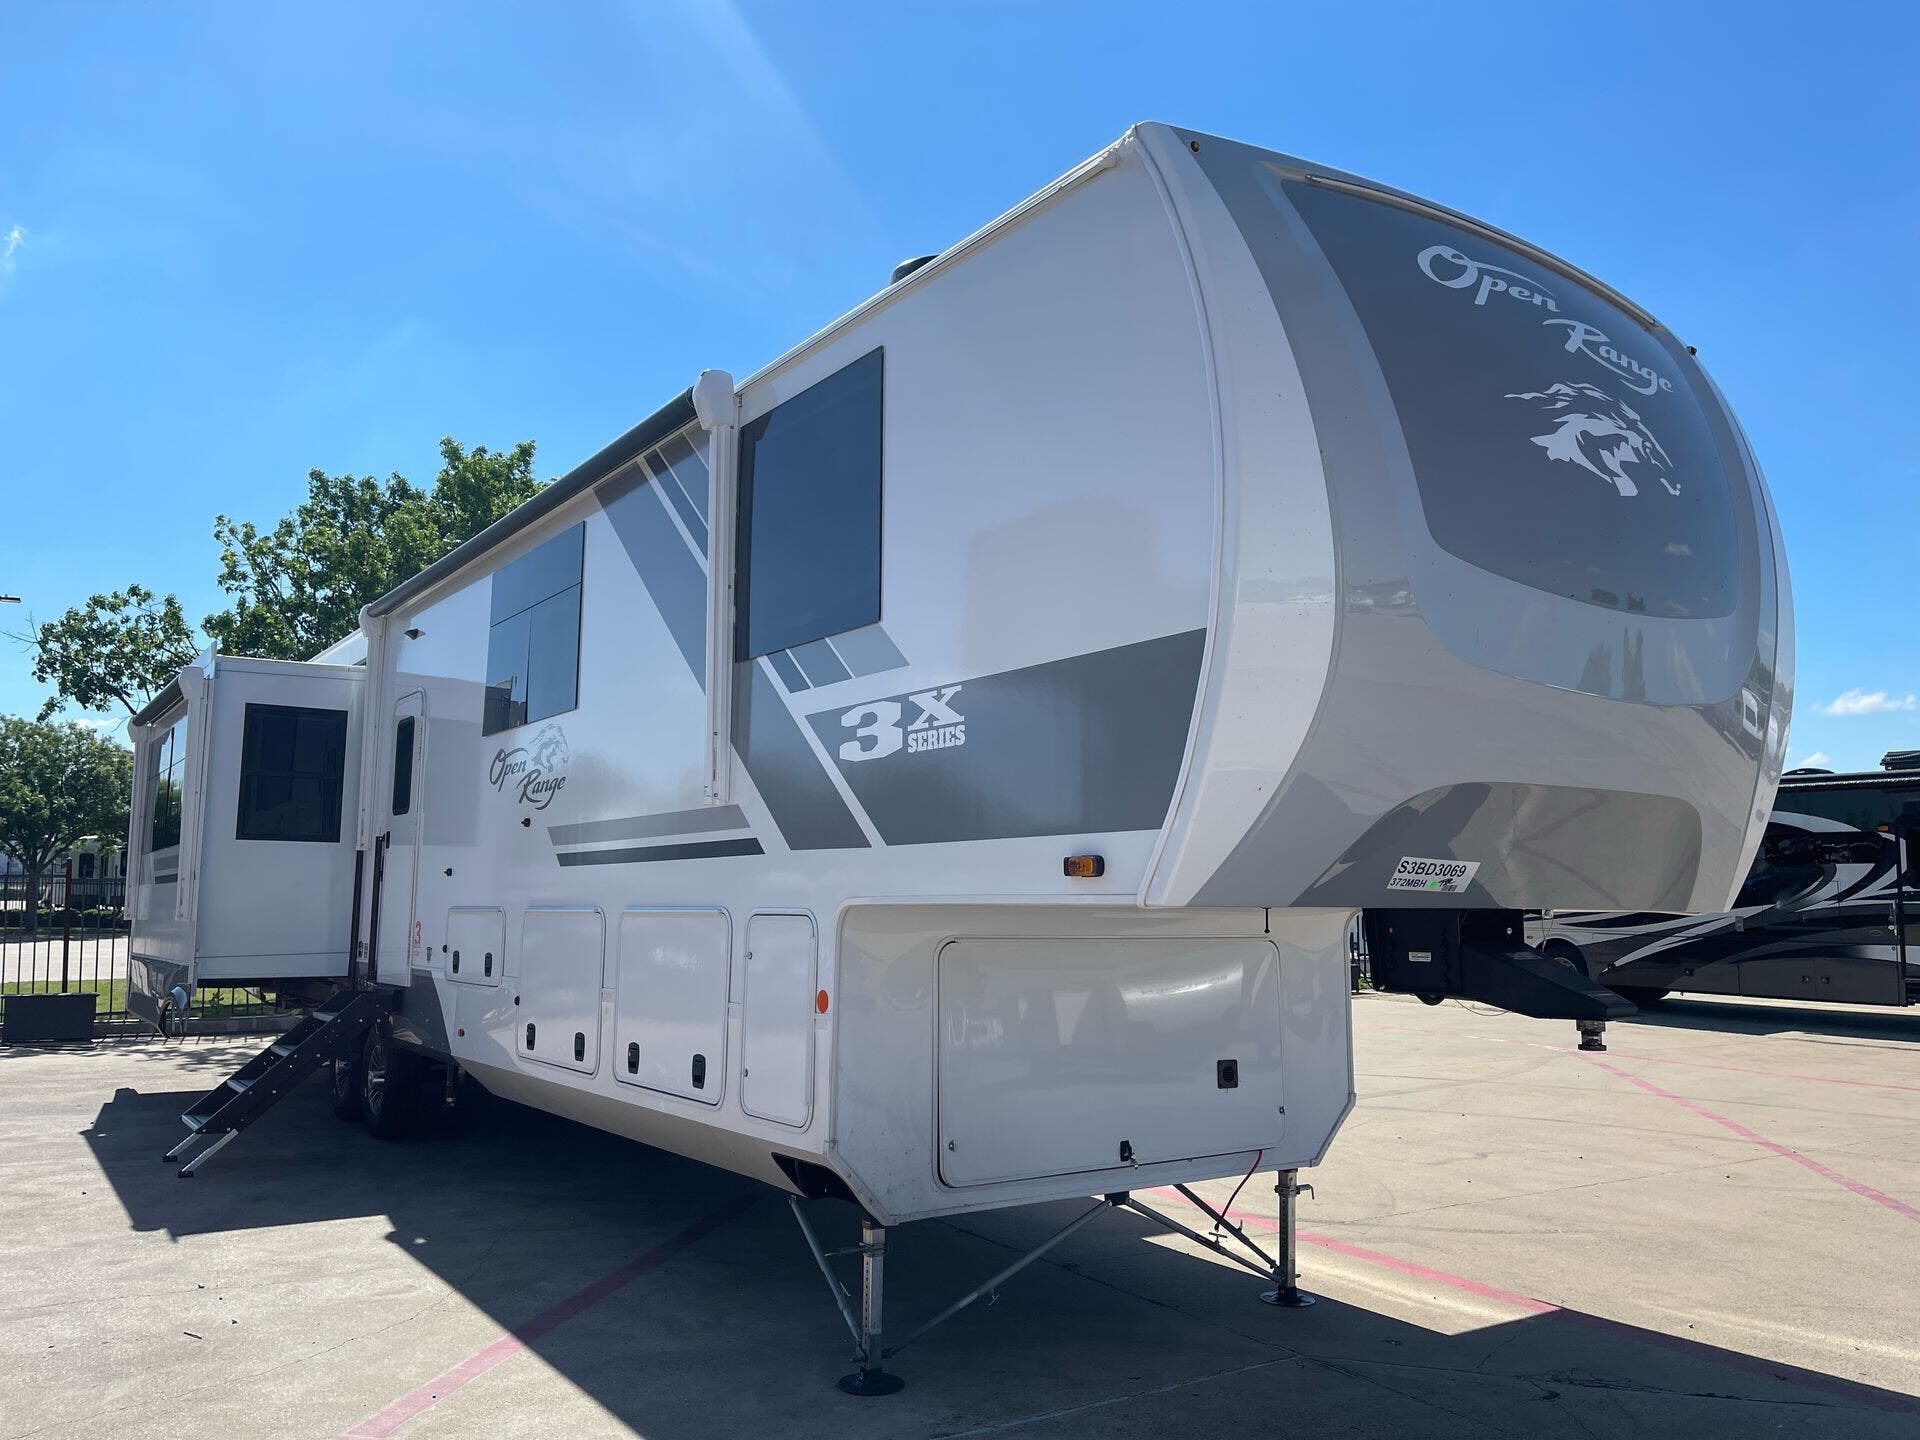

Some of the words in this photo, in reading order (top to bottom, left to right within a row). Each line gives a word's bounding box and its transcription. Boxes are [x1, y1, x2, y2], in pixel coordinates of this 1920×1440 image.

[1417, 245, 1560, 312] Open
[1542, 318, 1673, 396] Range
[907, 724, 966, 754] SERIES
[489, 747, 530, 793] Open
[516, 768, 567, 811] Range
[1390, 877, 1427, 888] 372MBH
[1397, 860, 1467, 878] S3BD3069
